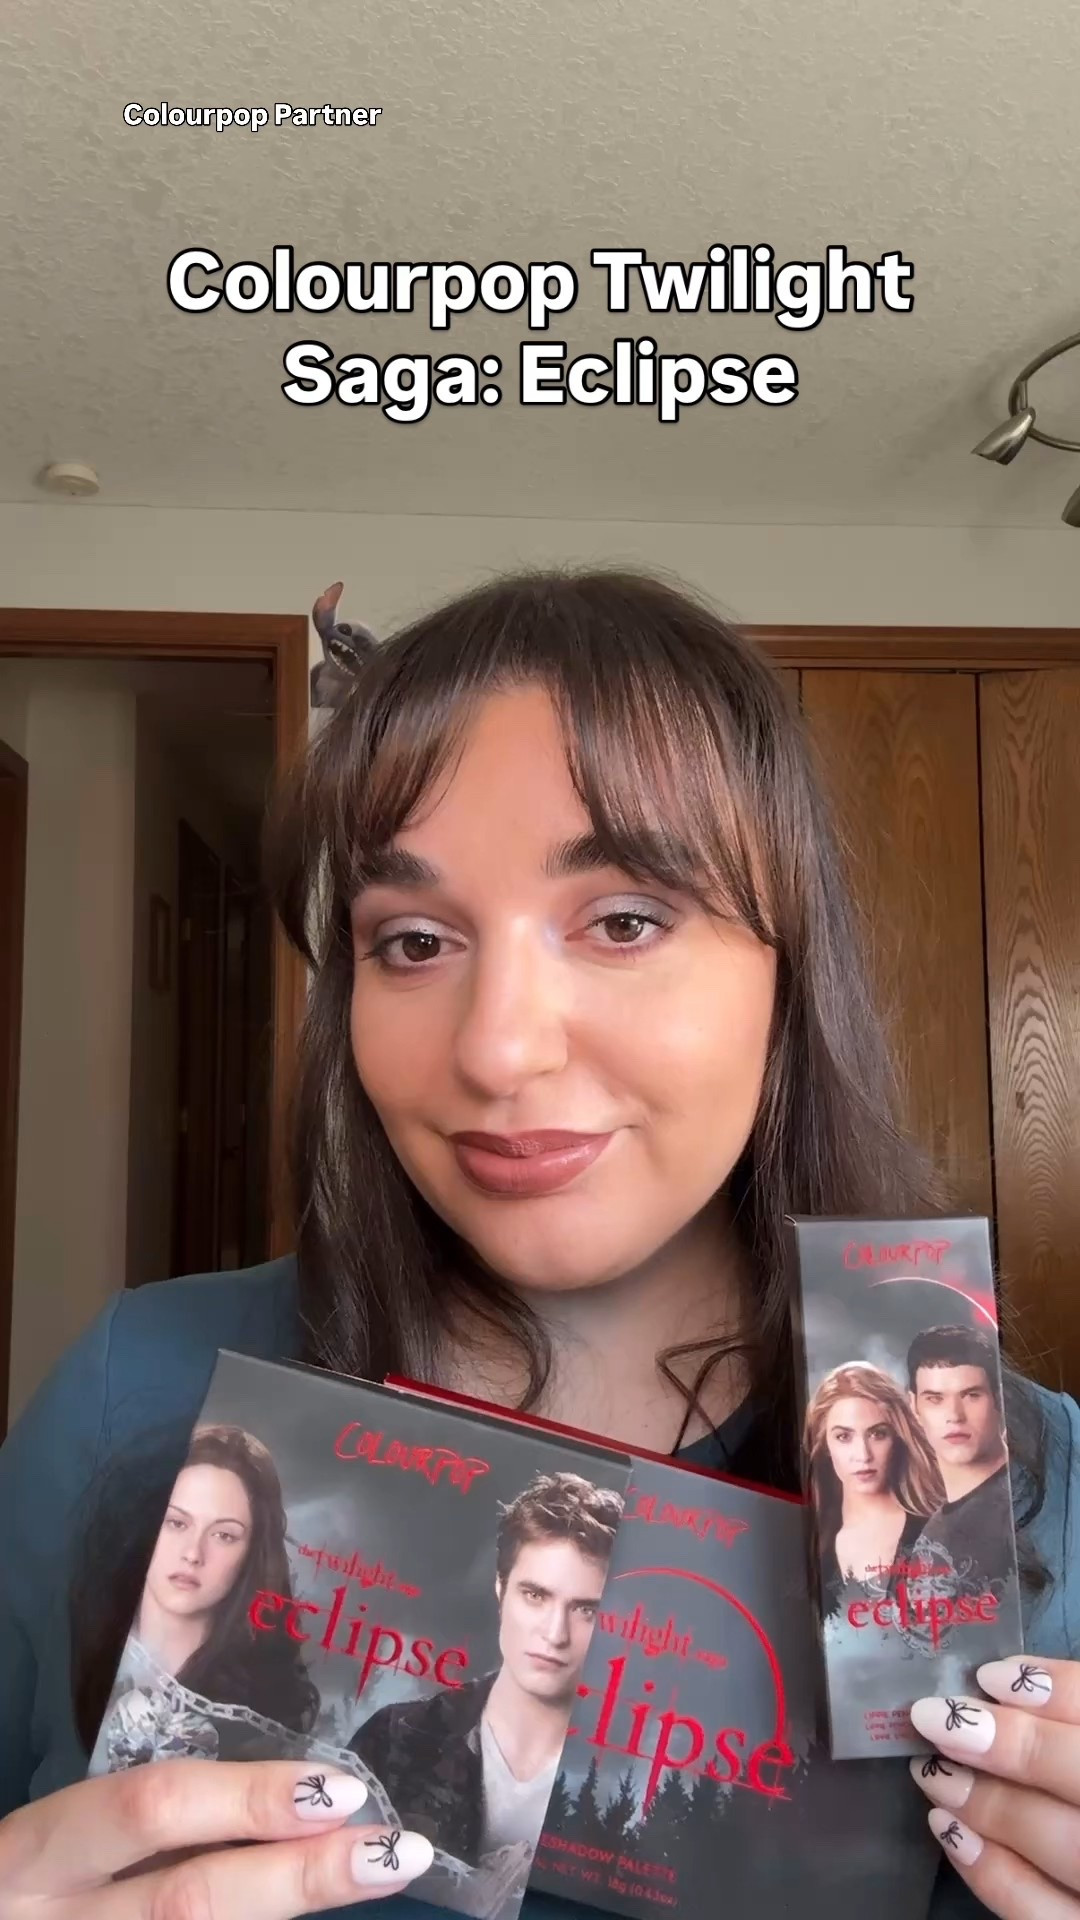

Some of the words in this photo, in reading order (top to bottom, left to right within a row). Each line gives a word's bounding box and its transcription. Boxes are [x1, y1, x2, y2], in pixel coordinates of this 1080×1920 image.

[843, 1239, 952, 1270] COLOURPOP
[334, 1420, 491, 1495] COLOURPOP
[248, 1586, 468, 1705] eclipse
[847, 1582, 1000, 1650] eclipse
